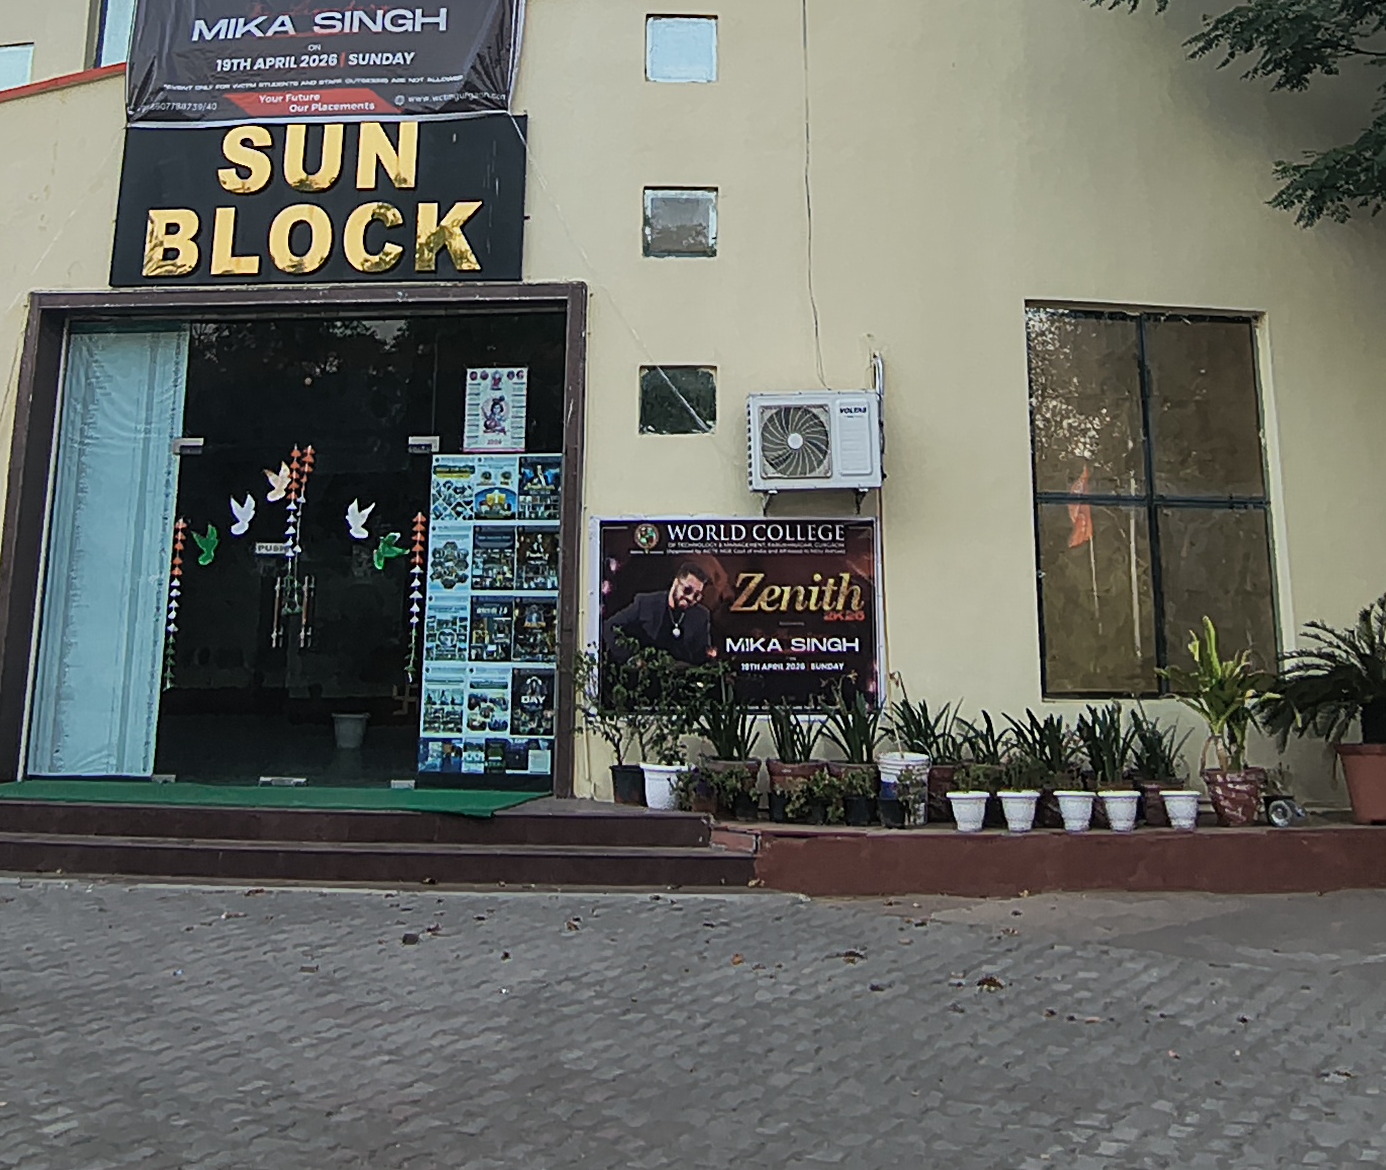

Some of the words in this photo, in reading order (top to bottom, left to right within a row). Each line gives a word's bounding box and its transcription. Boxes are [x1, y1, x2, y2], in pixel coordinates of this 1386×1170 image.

[191, 14, 296, 42] MIKA
[313, 7, 448, 34] SINGH
[307, 43, 322, 52] ON
[216, 57, 252, 72] 19TH
[253, 56, 298, 71] APRIL
[299, 54, 338, 68] 2026
[348, 51, 415, 66] SUNDAY
[408, 76, 424, 84] NOT
[259, 94, 283, 104] Your
[285, 92, 321, 103] Future
[289, 104, 310, 113] Our
[311, 102, 375, 112] Placements
[217, 121, 419, 194] SUN
[141, 200, 484, 277] BLOCK
[667, 524, 746, 541] WORLD
[751, 524, 845, 541] COLLEGE
[729, 572, 865, 612] Zenith
[725, 637, 783, 653] MIKA
[790, 637, 860, 653] SINGH
[761, 662, 784, 672] APRIL
[810, 662, 845, 672] SUNDAY
